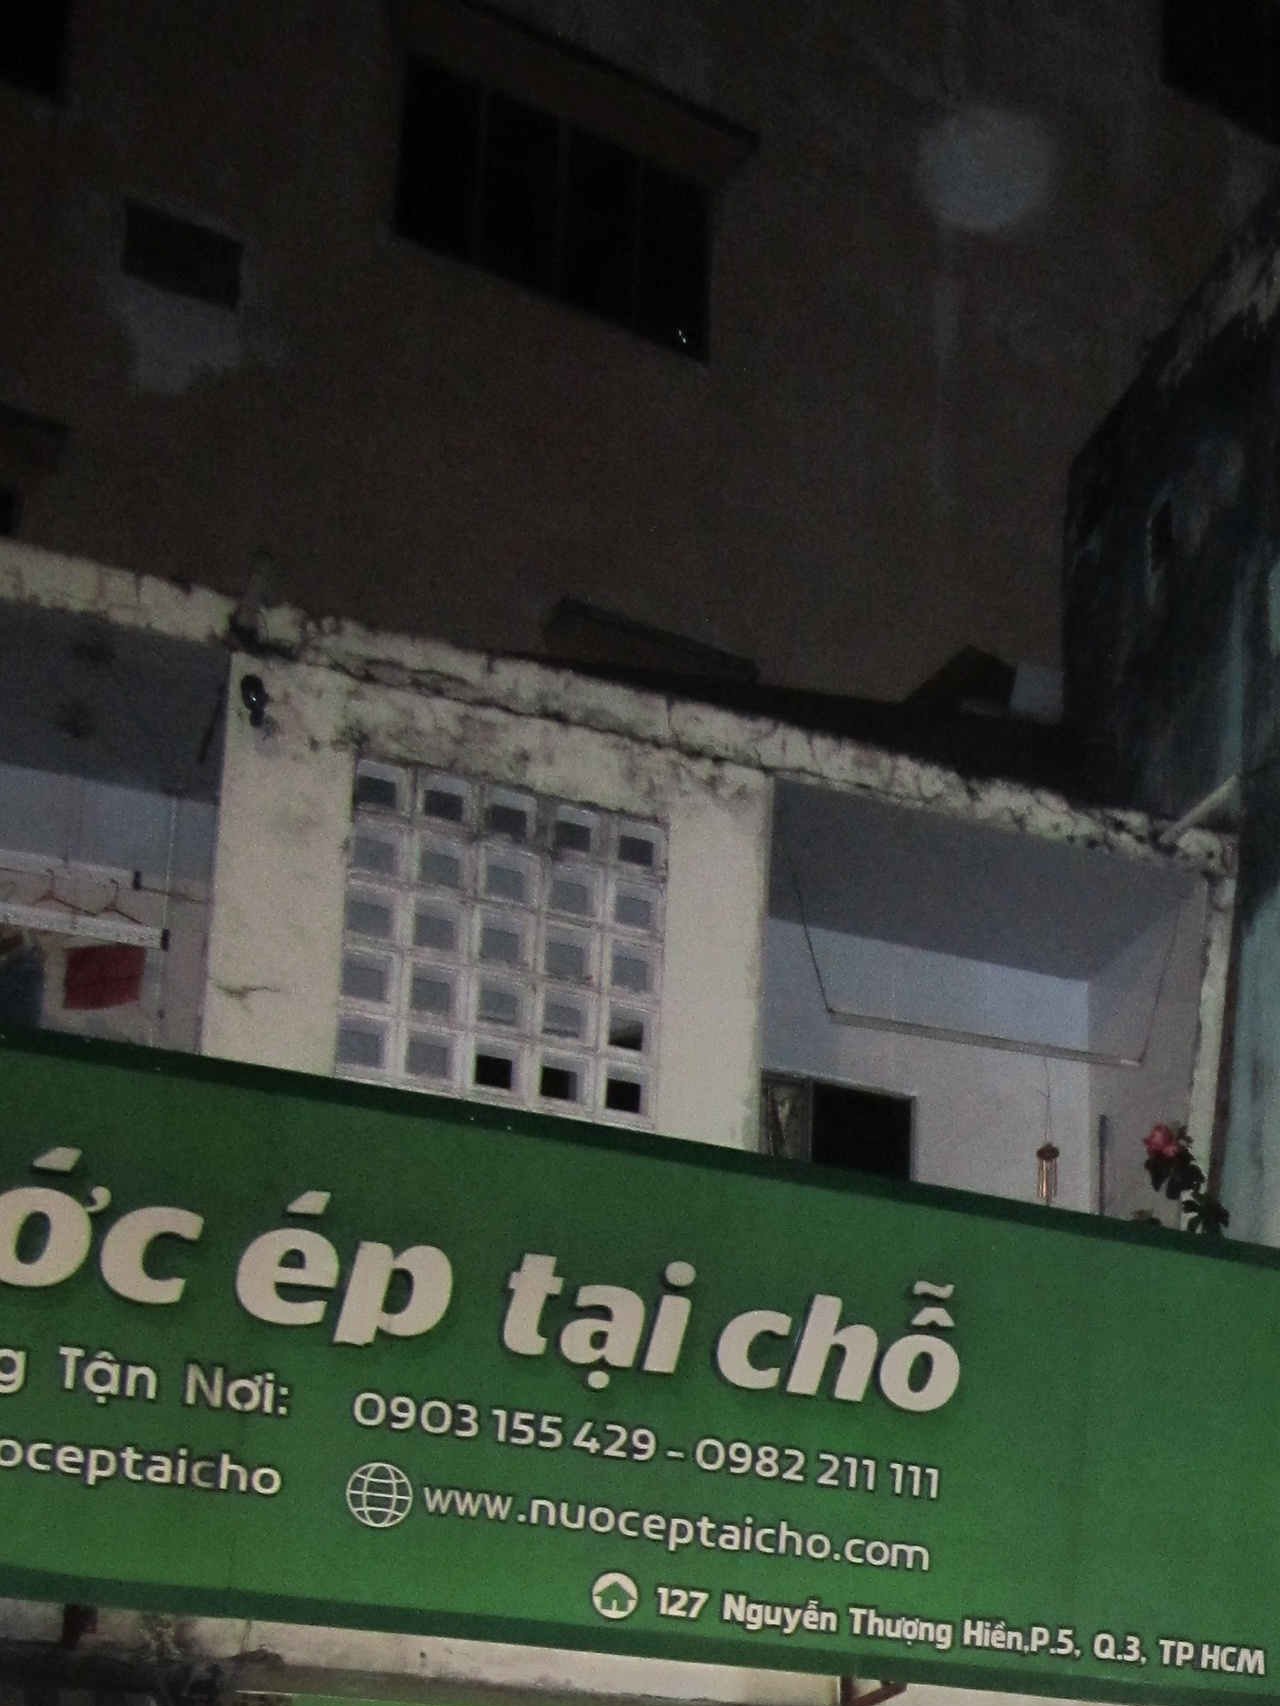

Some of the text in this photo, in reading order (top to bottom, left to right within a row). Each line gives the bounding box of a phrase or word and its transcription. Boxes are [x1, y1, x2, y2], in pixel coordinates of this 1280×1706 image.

[235, 1190, 454, 1346] ép
[502, 1253, 696, 1389] tại
[716, 1280, 960, 1411] chỗ
[59, 1347, 157, 1404] Tận
[186, 1364, 291, 1416] Nơi:
[0, 1437, 283, 1497] oceptaicho
[353, 1392, 479, 1439] 0903
[492, 1408, 562, 1447] 155
[573, 1422, 656, 1461] 429
[694, 1437, 804, 1482] 0982
[816, 1452, 876, 1491] 211
[891, 1463, 940, 1499] 111
[656, 1586, 708, 1617] 127
[722, 1594, 837, 1634] Nguyễn
[850, 1607, 952, 1648] Thượng
[1093, 1633, 1147, 1665] Q.3,
[1159, 1639, 1195, 1669] TP
[1201, 1645, 1265, 1676] HCM
